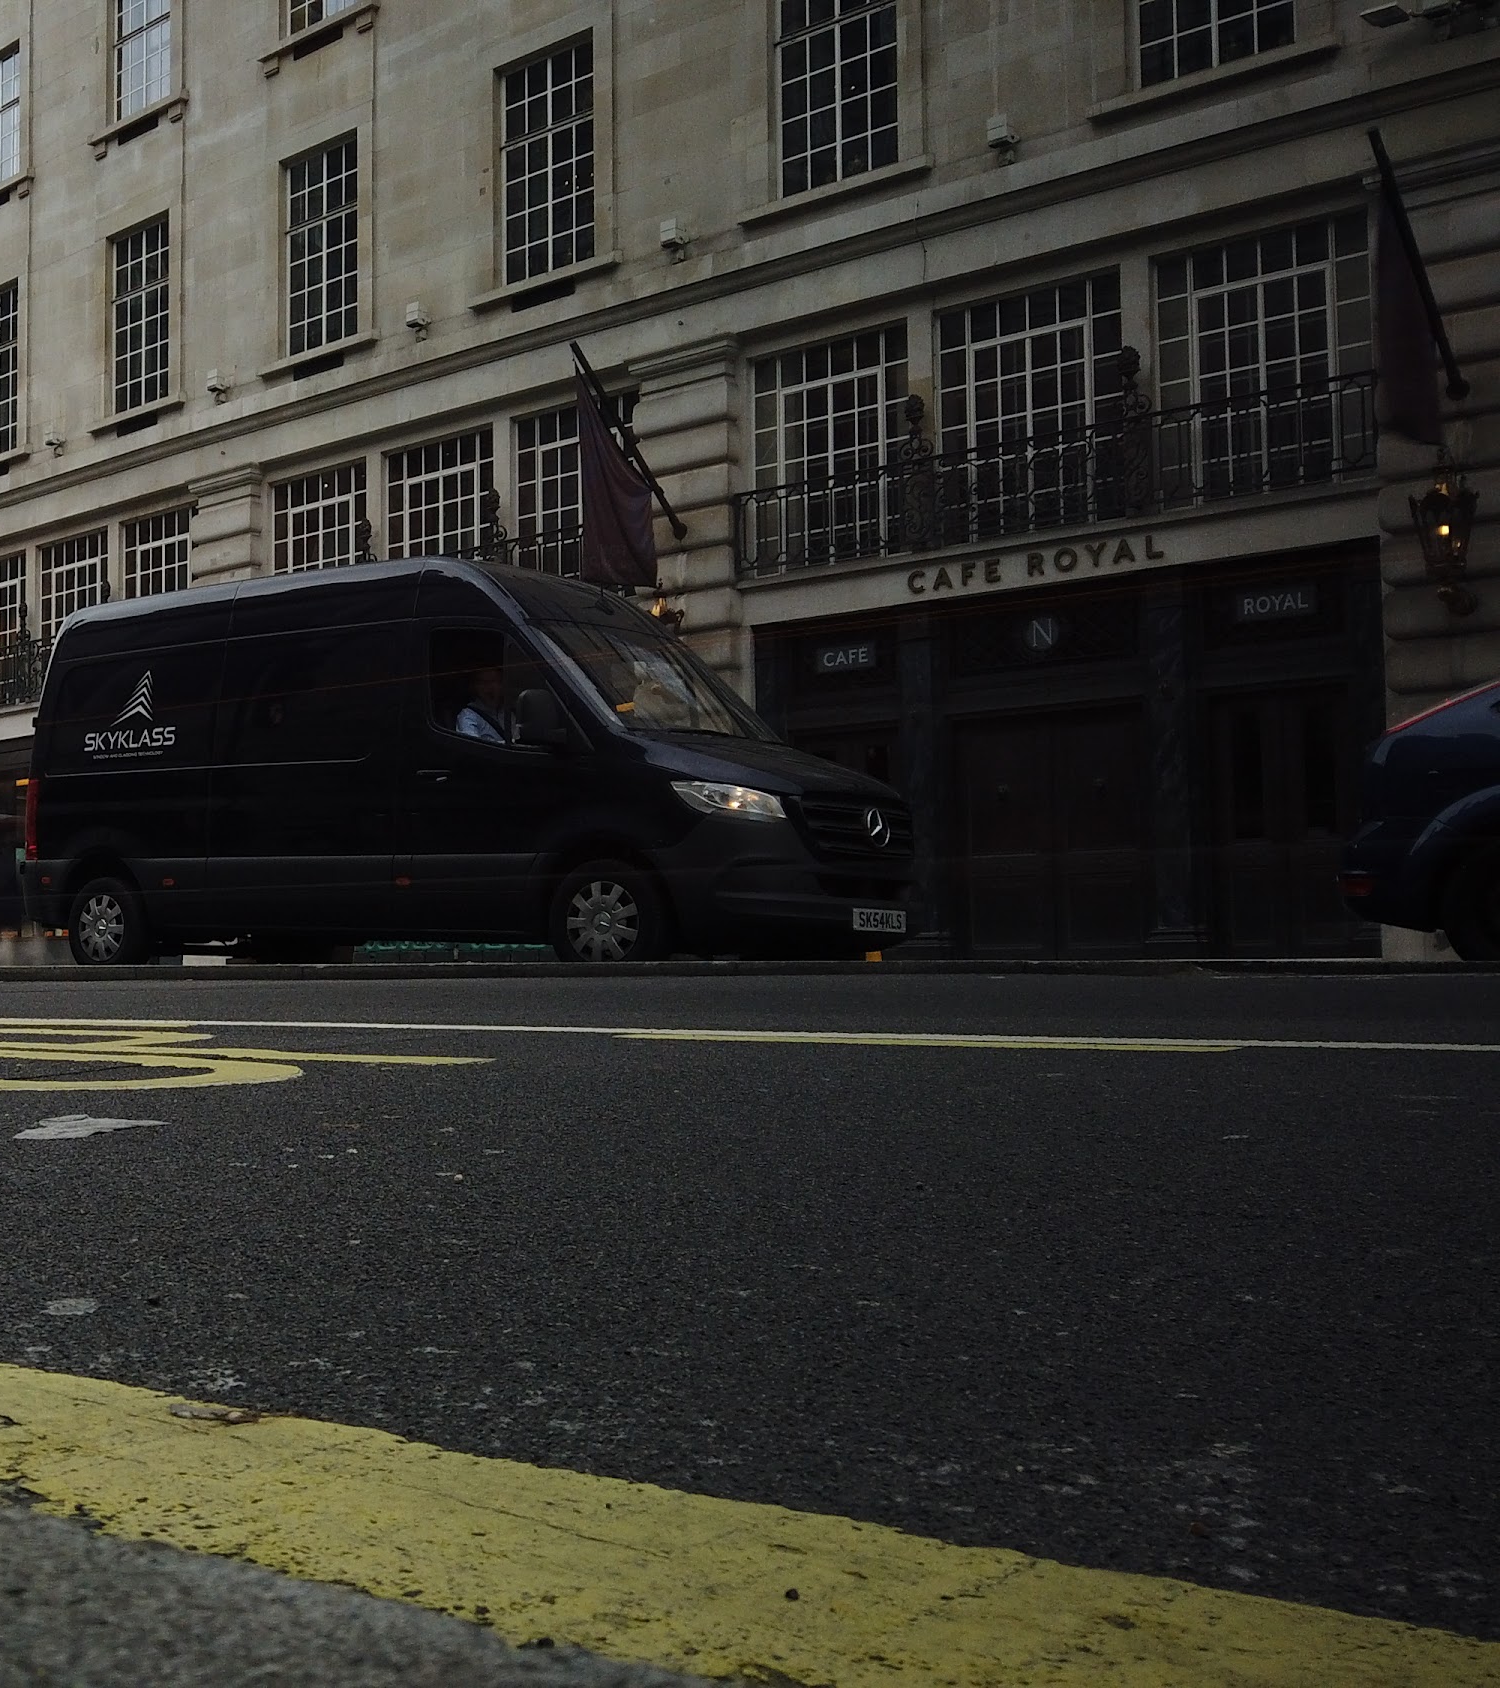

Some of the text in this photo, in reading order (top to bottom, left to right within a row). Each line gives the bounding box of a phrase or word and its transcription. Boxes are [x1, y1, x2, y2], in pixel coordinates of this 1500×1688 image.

[907, 535, 1164, 594] CAFE ROYAL
[1243, 591, 1309, 615] ROYAL
[1031, 617, 1053, 647] N
[84, 727, 176, 751] SKYKLASS
